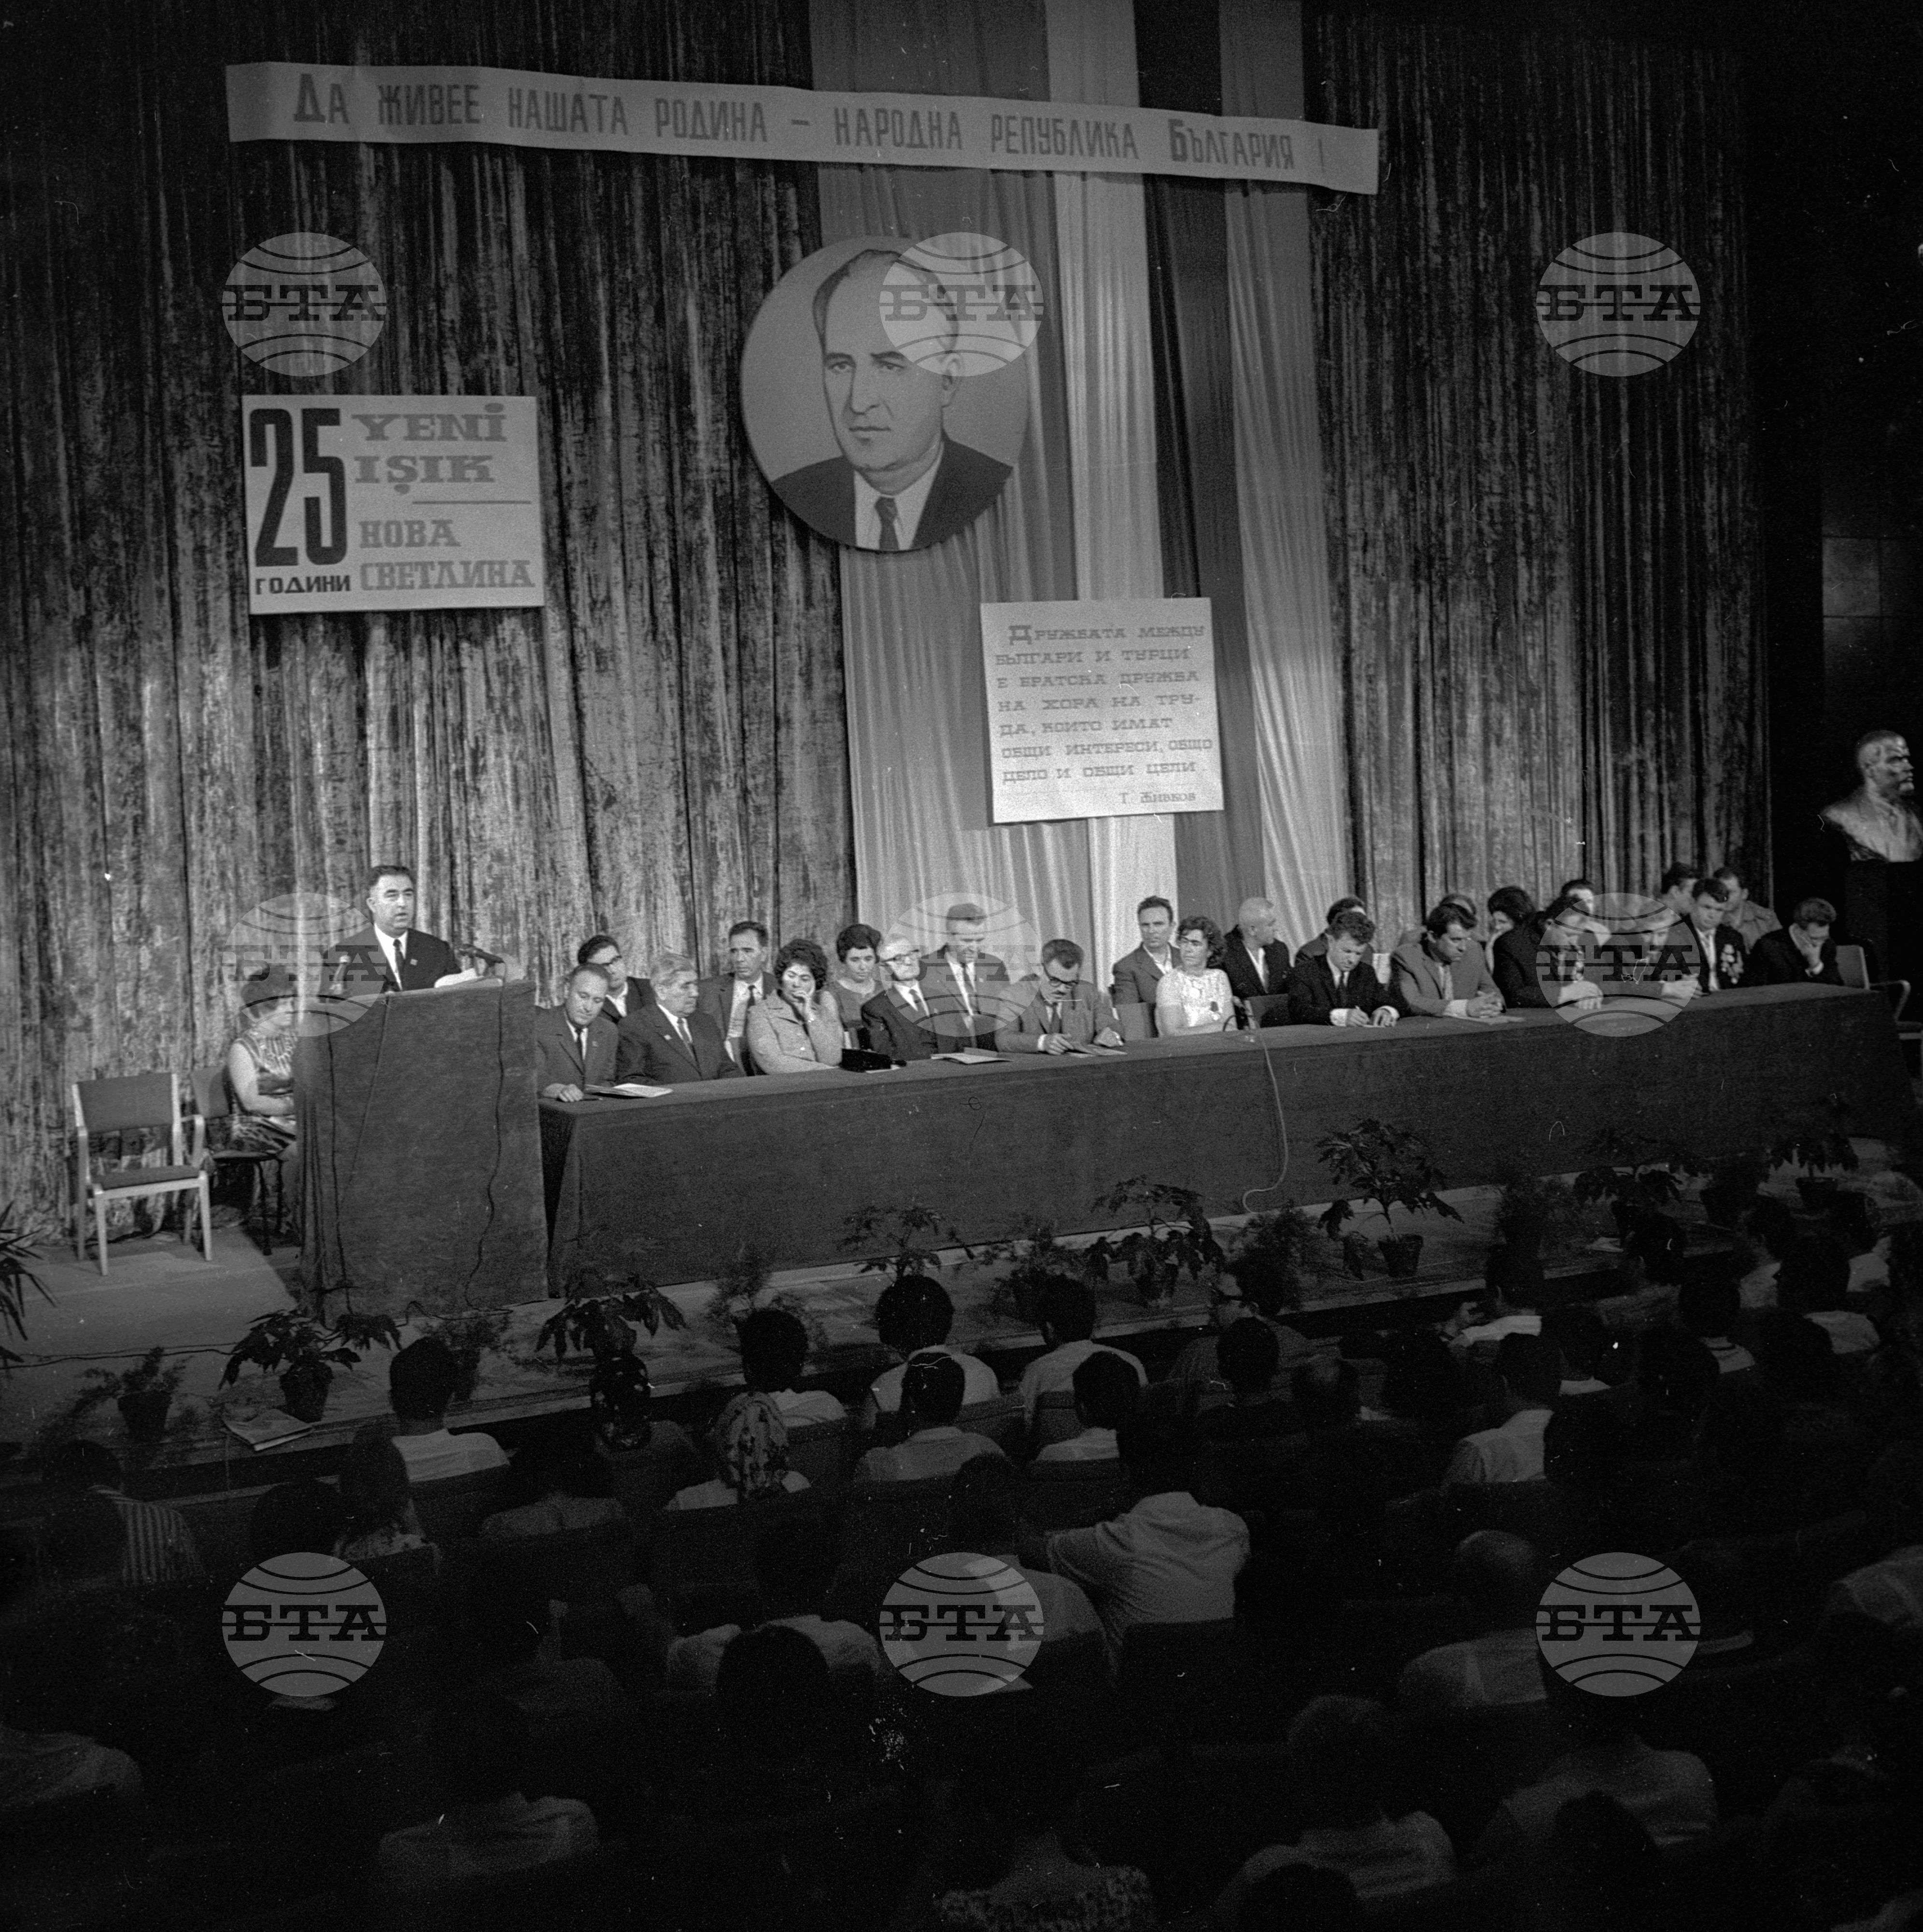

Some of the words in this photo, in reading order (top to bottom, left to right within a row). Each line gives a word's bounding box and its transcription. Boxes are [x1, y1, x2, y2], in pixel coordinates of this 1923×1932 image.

[294, 73, 350, 124] ДА
[377, 84, 481, 125] ЖИВЕЕ
[509, 87, 627, 135] НАШАТА
[655, 98, 767, 142] РОДИНА
[834, 107, 962, 150] НАРОДНА
[991, 114, 1139, 159] РЕПУБЛИКА
[1168, 118, 1295, 169] БЪЛГАРИЯ
[354, 455, 495, 495] IŞIK
[250, 408, 348, 567] 25
[359, 519, 461, 548] НОВА
[255, 575, 351, 595] ГОДИНИ
[359, 560, 535, 591] СВЕТЛИНА
[1137, 626, 1204, 639] МЕЖДУ
[1095, 651, 1110, 662] И
[1121, 649, 1189, 662] ТУРЦИ
[997, 678, 1008, 688] Е
[1019, 674, 1106, 687] БРАТСКА
[1120, 671, 1199, 684] ДРУЖБА
[998, 701, 1027, 711] НА
[1042, 698, 1100, 710] ХОРА
[1112, 696, 1140, 707] НА
[1042, 721, 1101, 733] КОИТО
[1112, 718, 1173, 730] ИМАТ
[1001, 746, 1052, 759] ОБЩИ
[1168, 739, 1213, 752] ОБЩО
[1002, 769, 1047, 785] ДЕЛО
[1056, 768, 1071, 779] И
[1083, 765, 1134, 778] ОБЩИ
